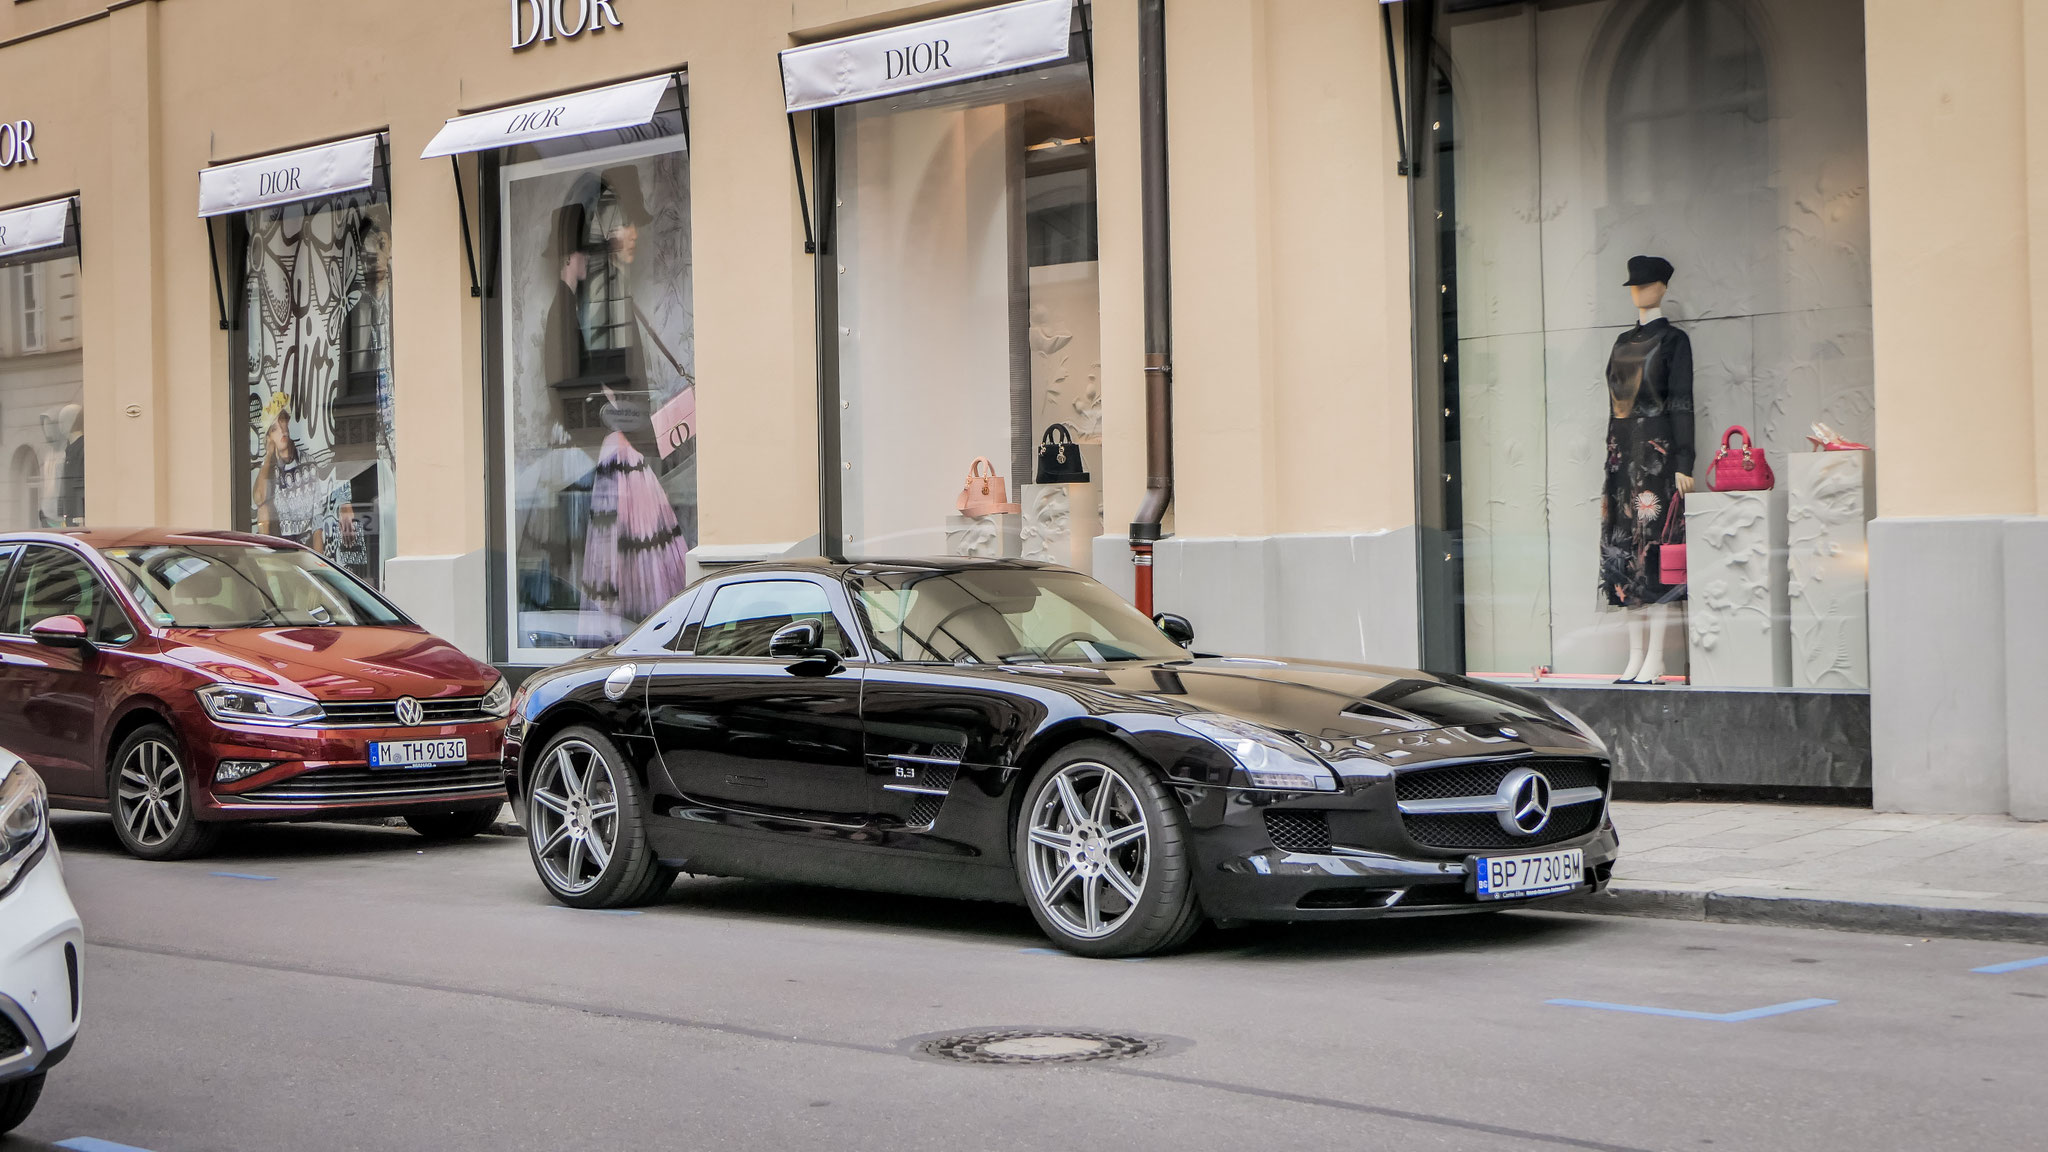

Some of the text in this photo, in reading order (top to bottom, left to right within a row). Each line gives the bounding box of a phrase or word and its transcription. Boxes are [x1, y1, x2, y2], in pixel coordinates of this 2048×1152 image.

[884, 39, 952, 80] DIOR
[505, 106, 566, 134] DIOR
[0, 119, 37, 167] OR
[259, 167, 300, 196] DIOR
[381, 741, 465, 761] M TH 9030
[1478, 880, 1488, 889] BG
[1492, 853, 1580, 888] BP 7730 BM
